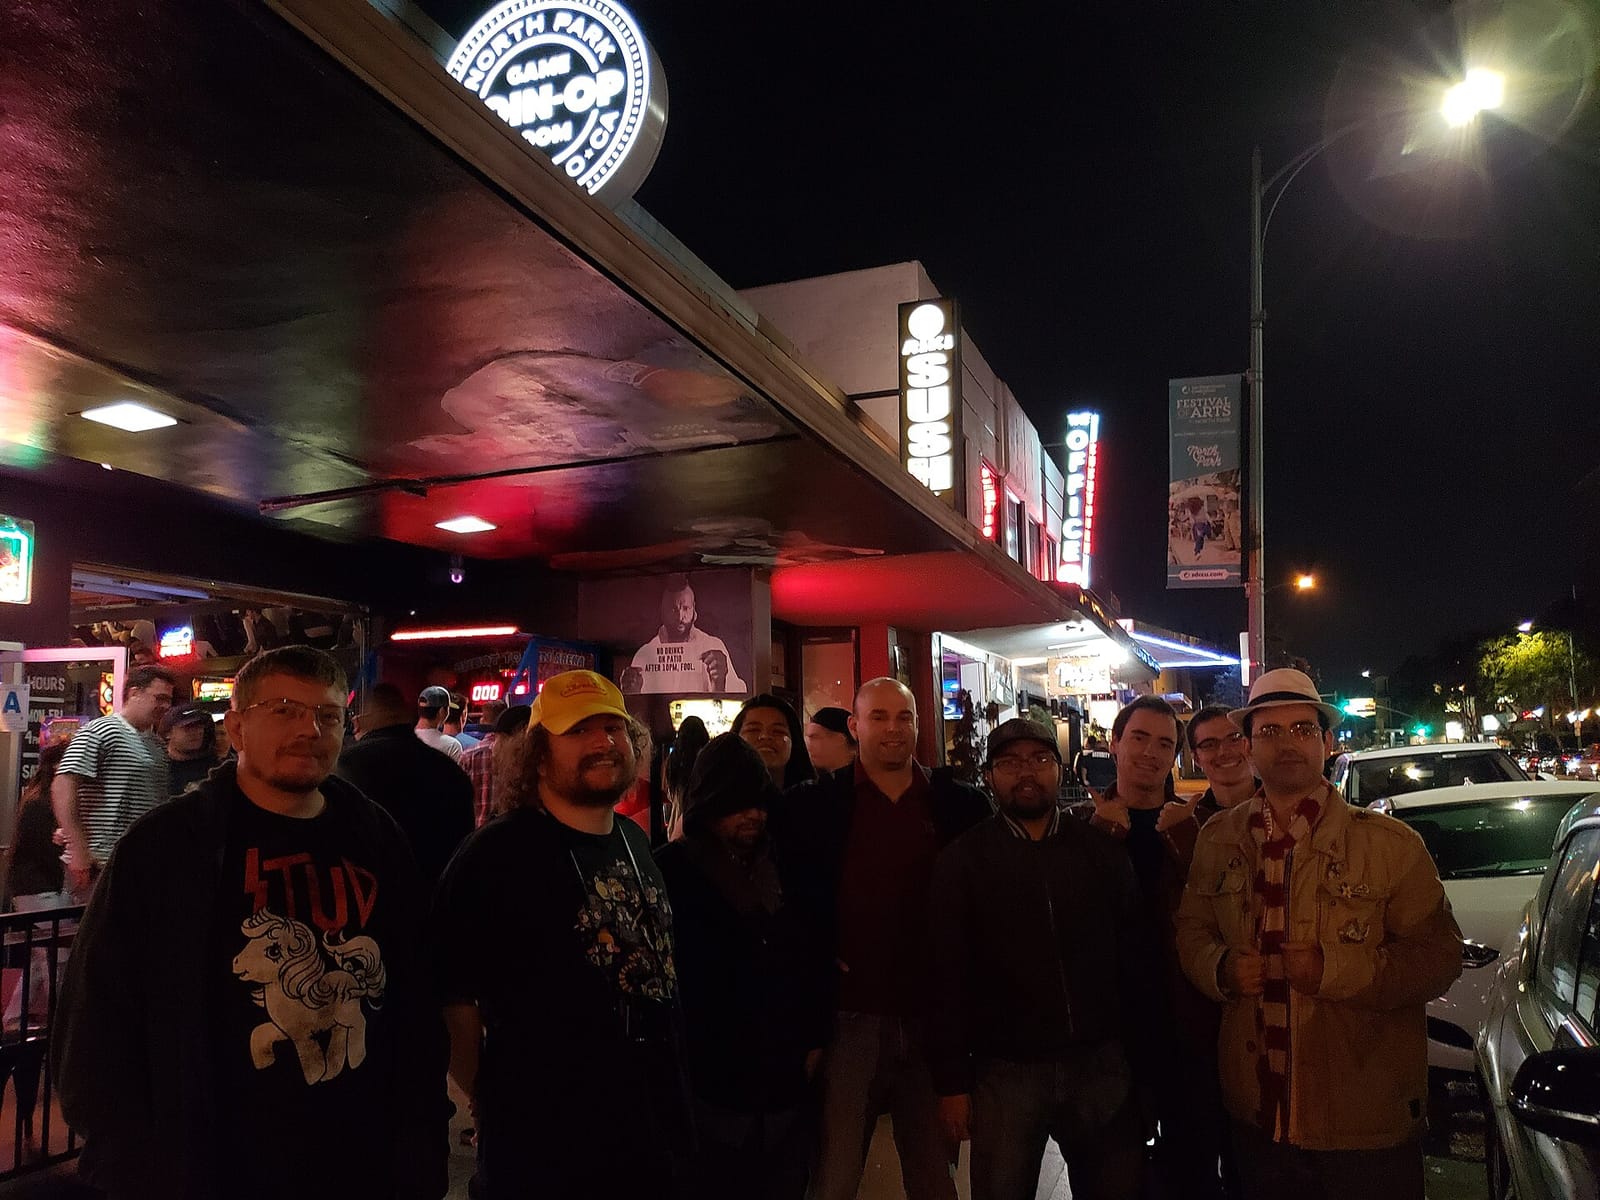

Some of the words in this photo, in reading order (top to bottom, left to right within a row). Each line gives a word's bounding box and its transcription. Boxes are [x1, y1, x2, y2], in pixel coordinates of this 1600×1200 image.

[464, 14, 545, 92] NORTH
[553, 12, 616, 63] PARK
[506, 53, 571, 86] GAME
[484, 69, 626, 127] IN-OP
[590, 111, 620, 150] CA
[1177, 397, 1231, 409] FESTIVAL
[1190, 406, 1232, 418] ARTS
[906, 352, 953, 497] SUSH
[1062, 429, 1090, 562] OFFICE
[656, 647, 664, 655] NO
[665, 646, 684, 655] DRINKS
[658, 655, 666, 663] ON
[667, 655, 682, 663] PATIO
[645, 663, 661, 672] AFTER
[681, 662, 696, 672] FOOL.
[27, 675, 65, 691] HOURS
[472, 684, 500, 701] 000
[2, 691, 21, 713] A
[244, 848, 377, 935] STUD
